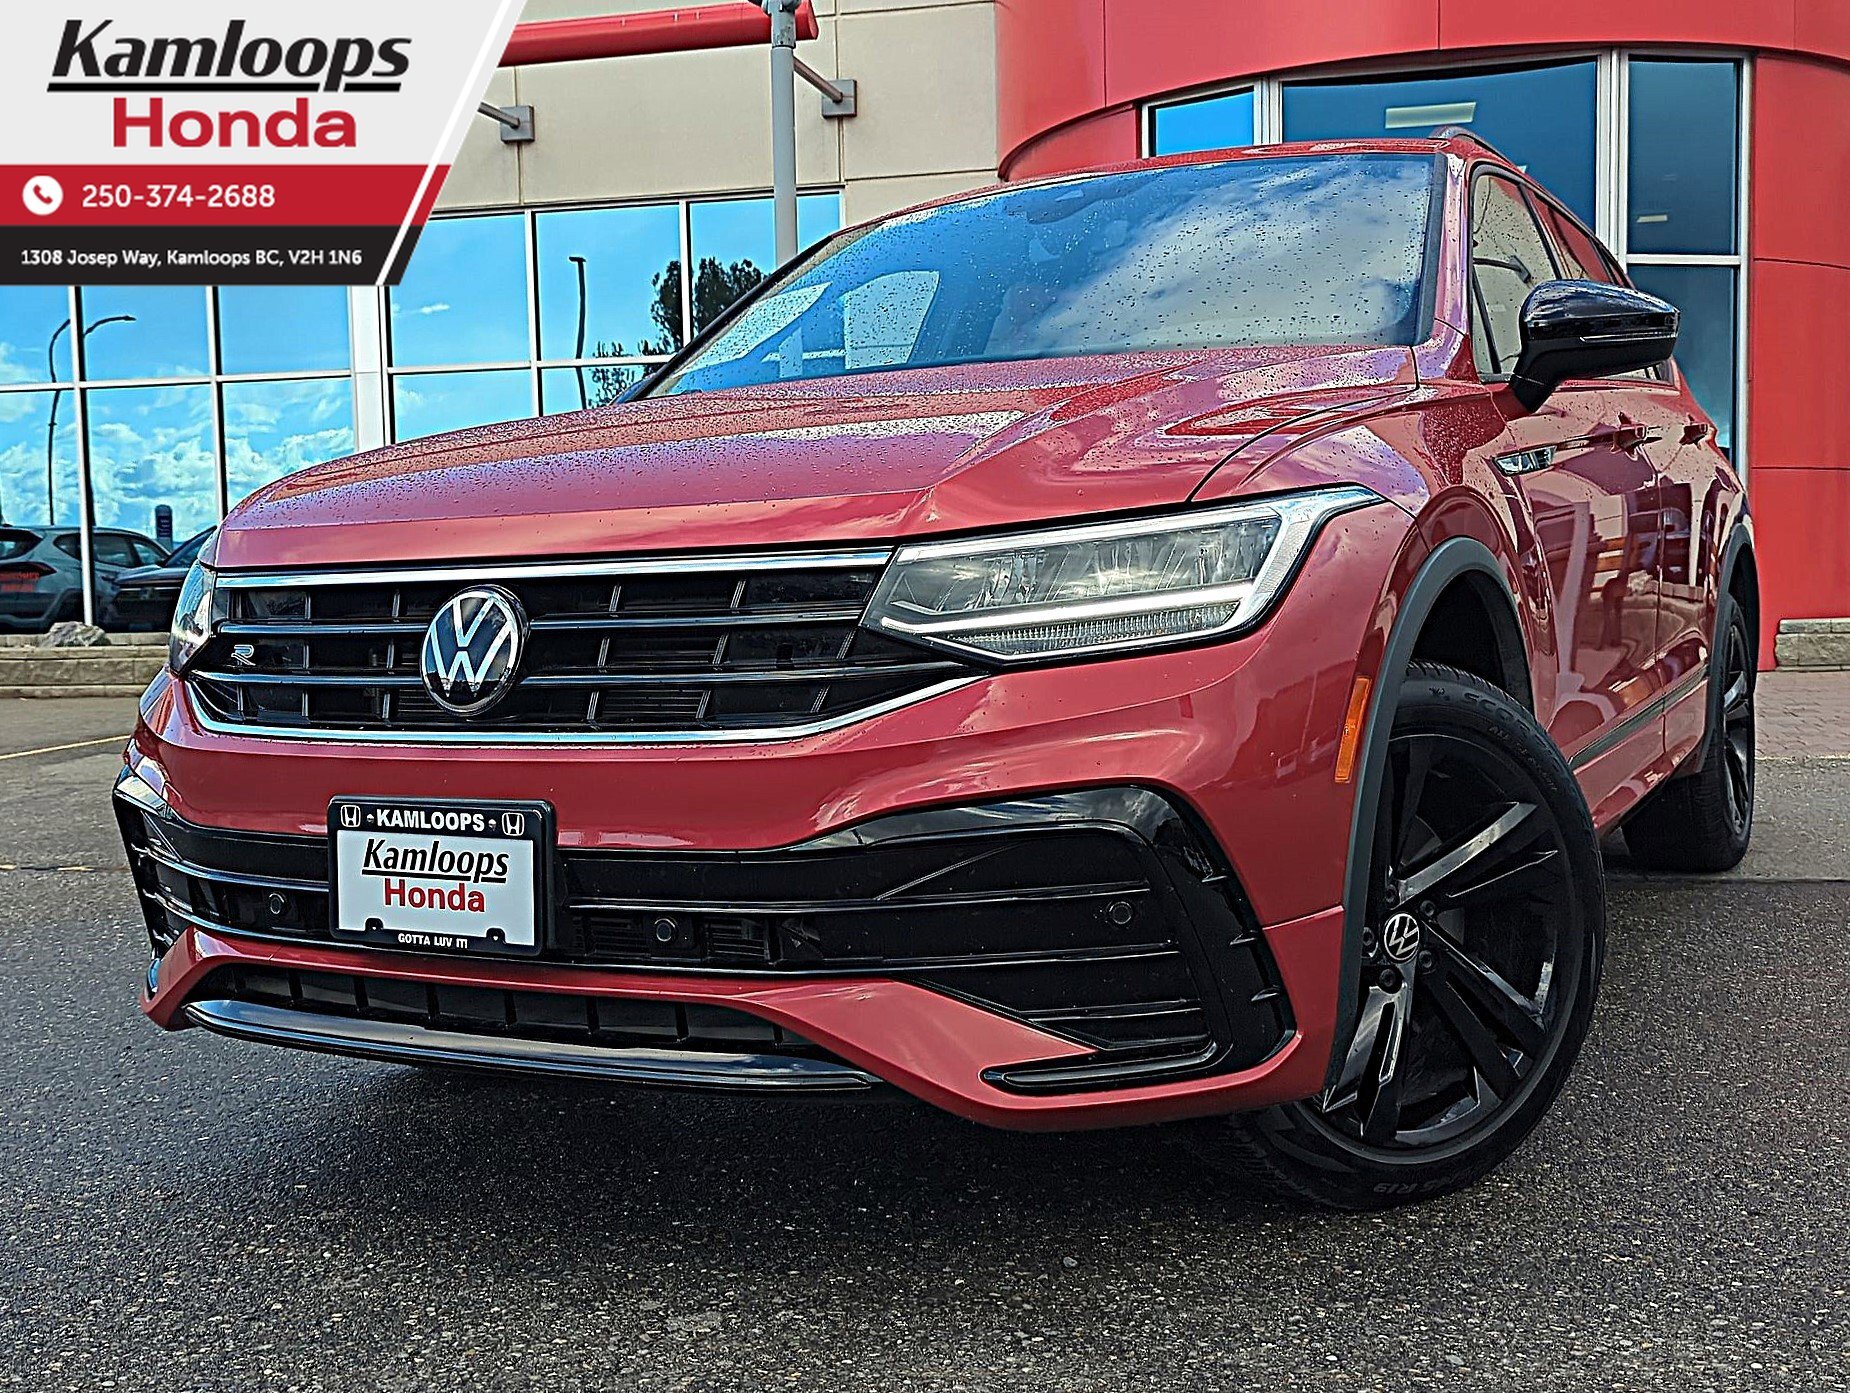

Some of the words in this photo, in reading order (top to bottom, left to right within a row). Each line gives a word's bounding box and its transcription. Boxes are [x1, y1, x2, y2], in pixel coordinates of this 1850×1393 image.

[376, 808, 485, 832] KAMLOOPS
[362, 838, 510, 883] Kamloops
[384, 878, 485, 913] Honda
[398, 932, 431, 946] GOTTA
[434, 935, 453, 948] LUV
